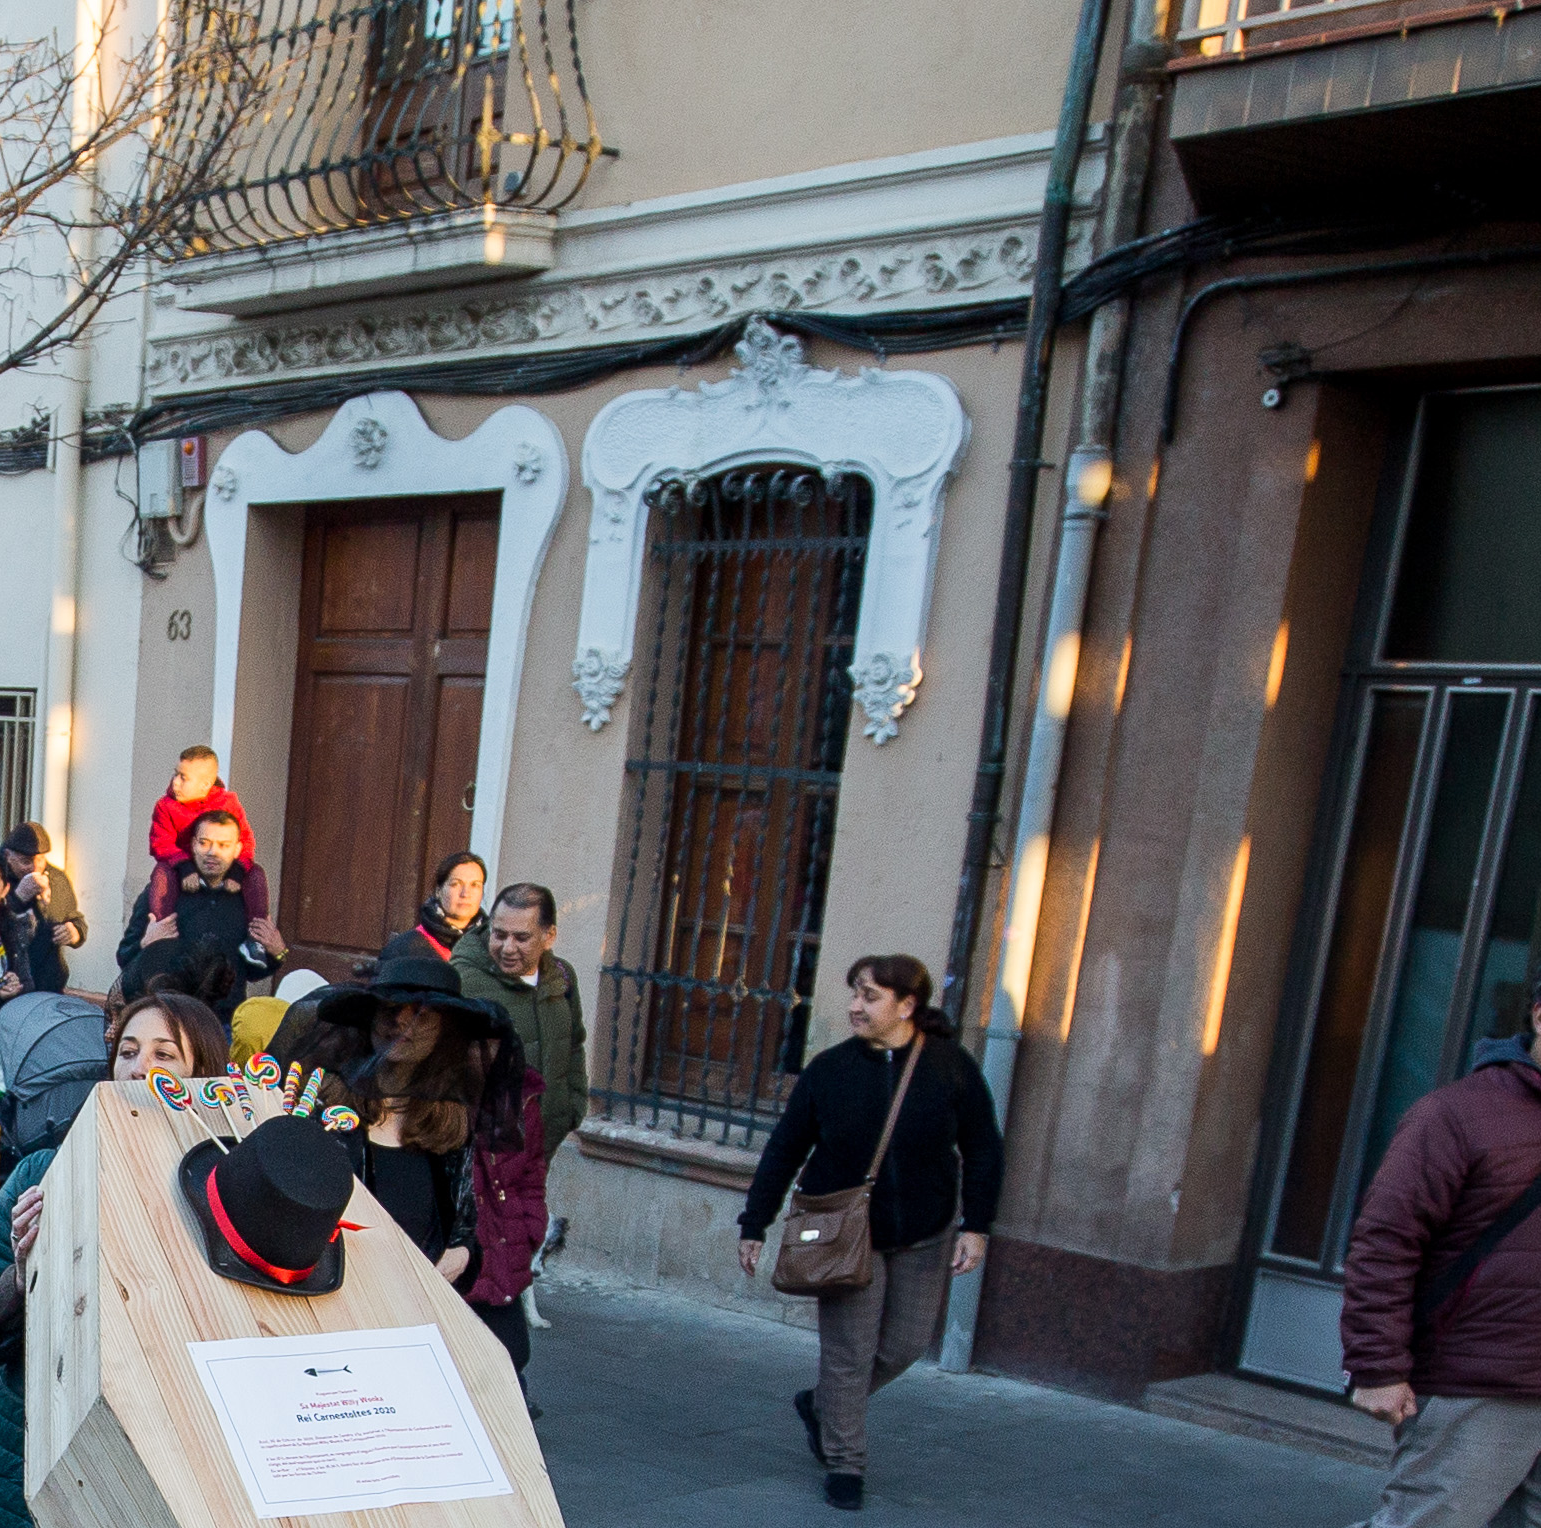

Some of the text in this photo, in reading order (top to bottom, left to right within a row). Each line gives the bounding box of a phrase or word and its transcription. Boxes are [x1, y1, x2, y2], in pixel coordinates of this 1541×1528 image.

[167, 609, 192, 641] 63
[310, 1400, 340, 1409] Majestat
[296, 1406, 397, 1423] Rei Carnestoltes 2020
